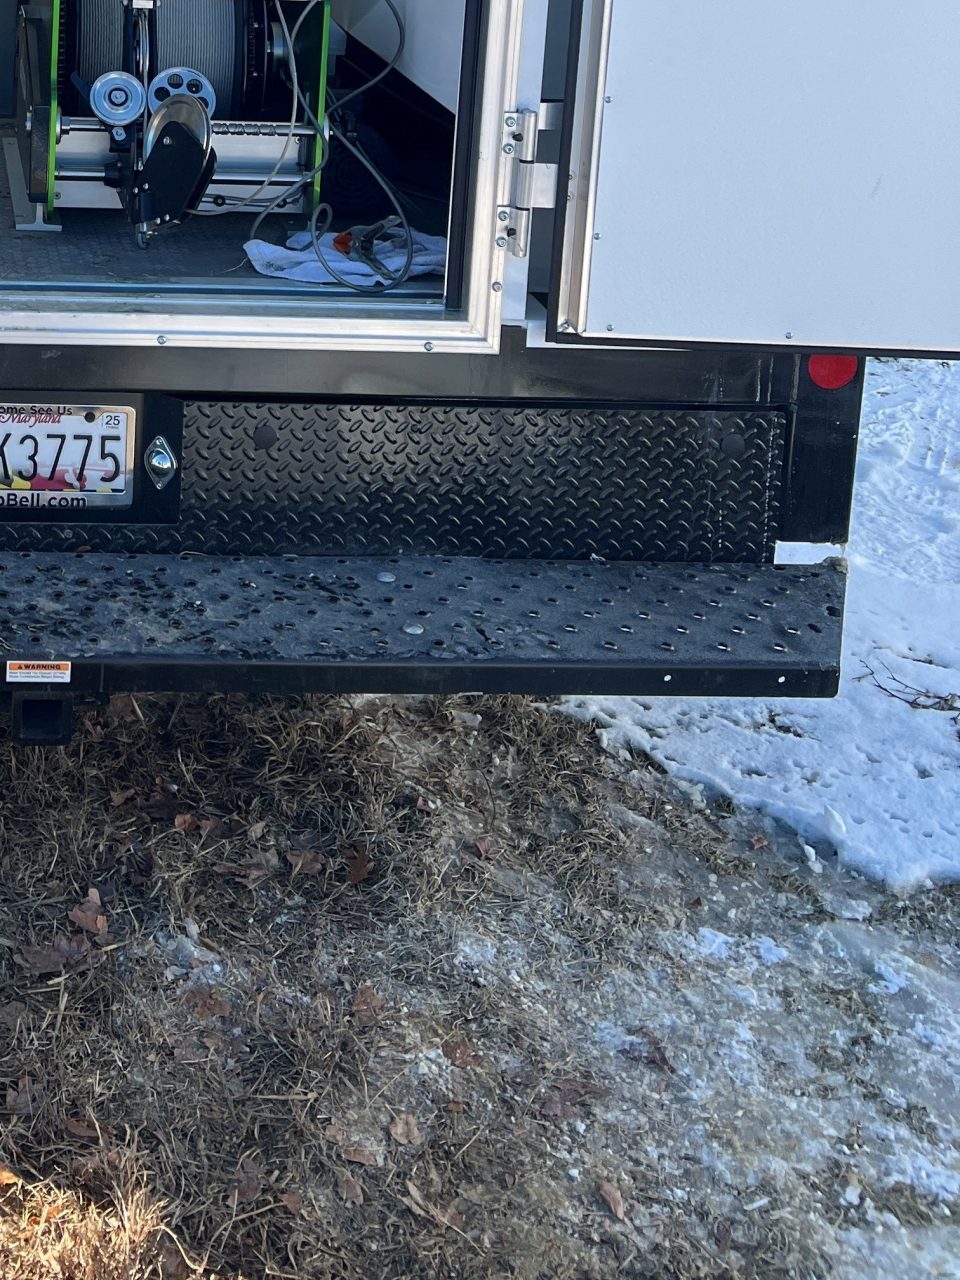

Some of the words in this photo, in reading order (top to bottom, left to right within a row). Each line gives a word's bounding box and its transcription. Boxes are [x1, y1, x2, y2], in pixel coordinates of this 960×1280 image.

[30, 405, 53, 415] See
[57, 406, 73, 416] Us
[105, 414, 120, 426] 25
[23, 663, 61, 671] WARNING
